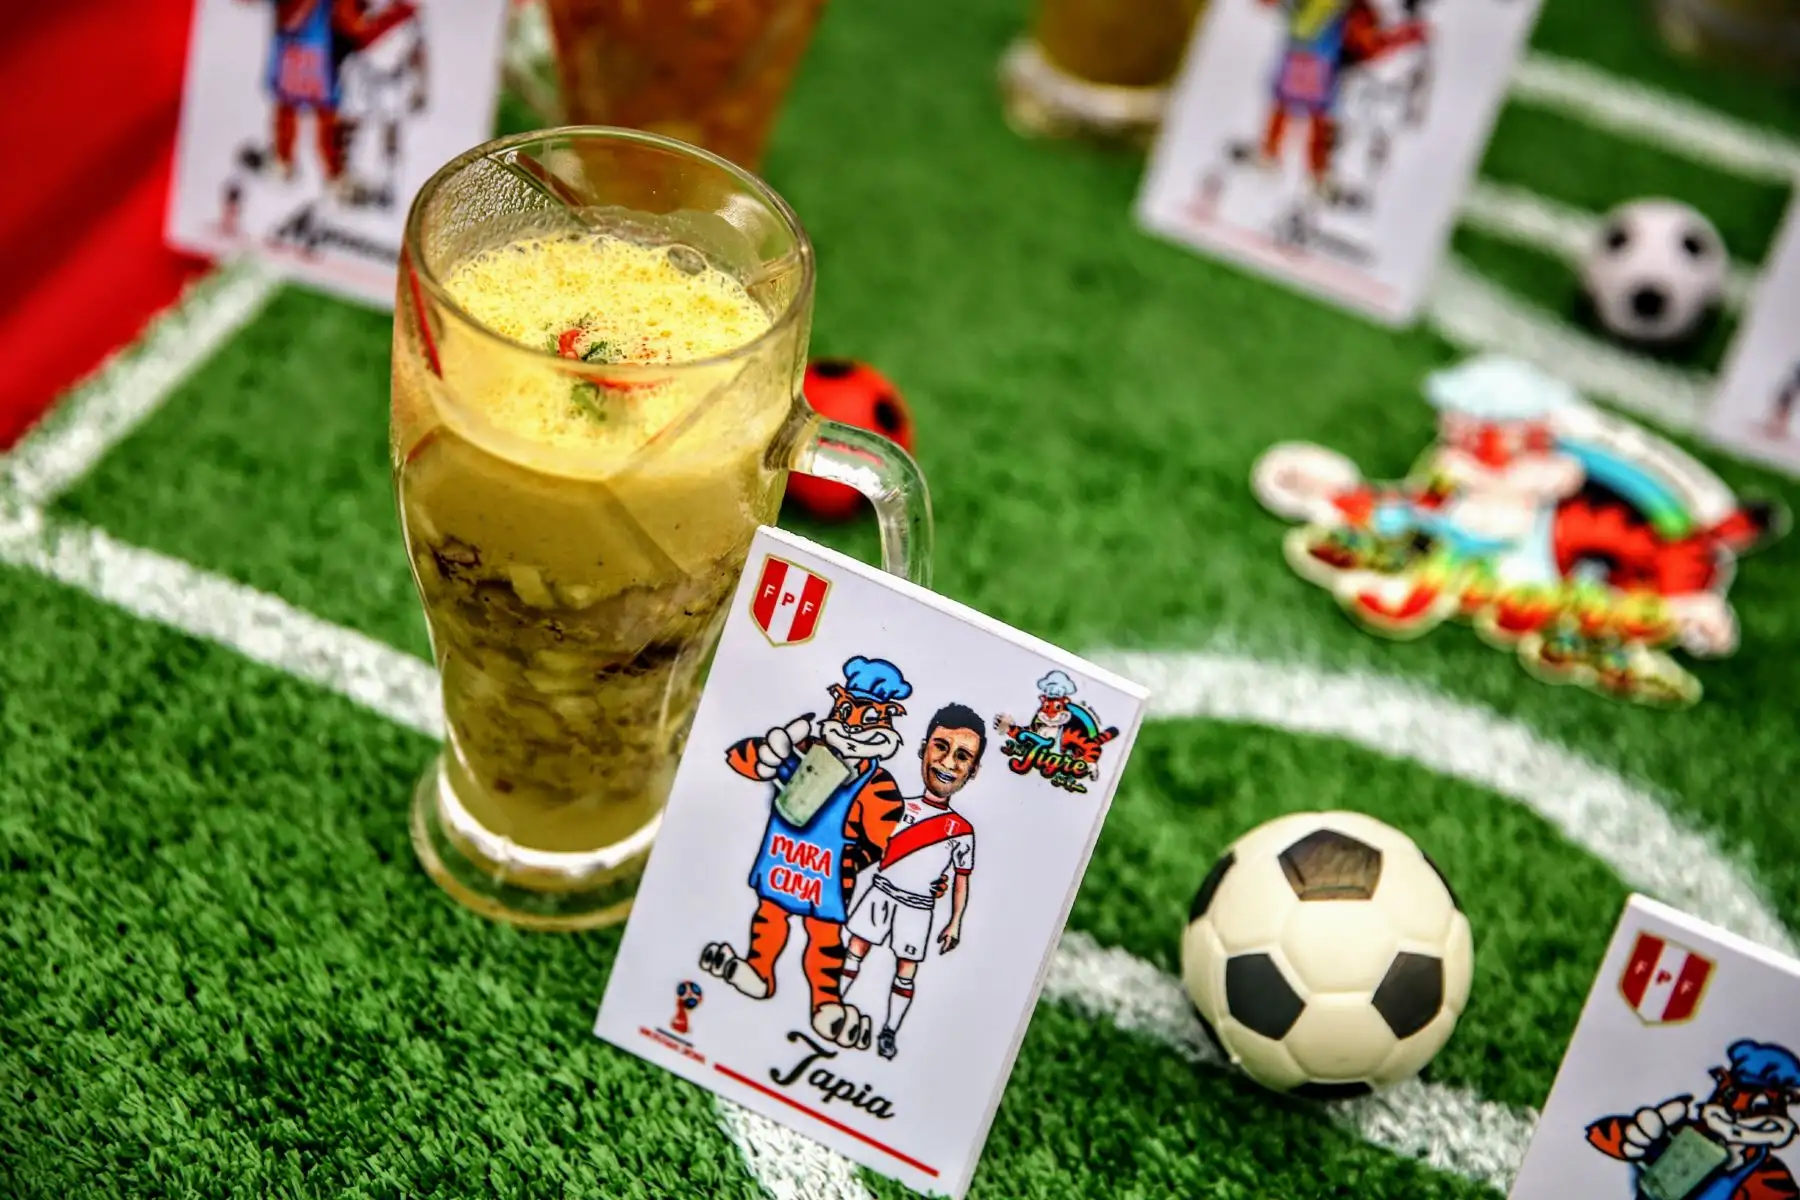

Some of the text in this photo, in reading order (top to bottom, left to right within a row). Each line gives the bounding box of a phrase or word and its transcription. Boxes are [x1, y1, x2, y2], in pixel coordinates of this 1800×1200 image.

[763, 584, 815, 615] FPF
[1009, 730, 1088, 779] Tigre
[769, 834, 833, 878] MARA
[768, 865, 823, 907] CUYA
[768, 1030, 896, 1119] Tapia
